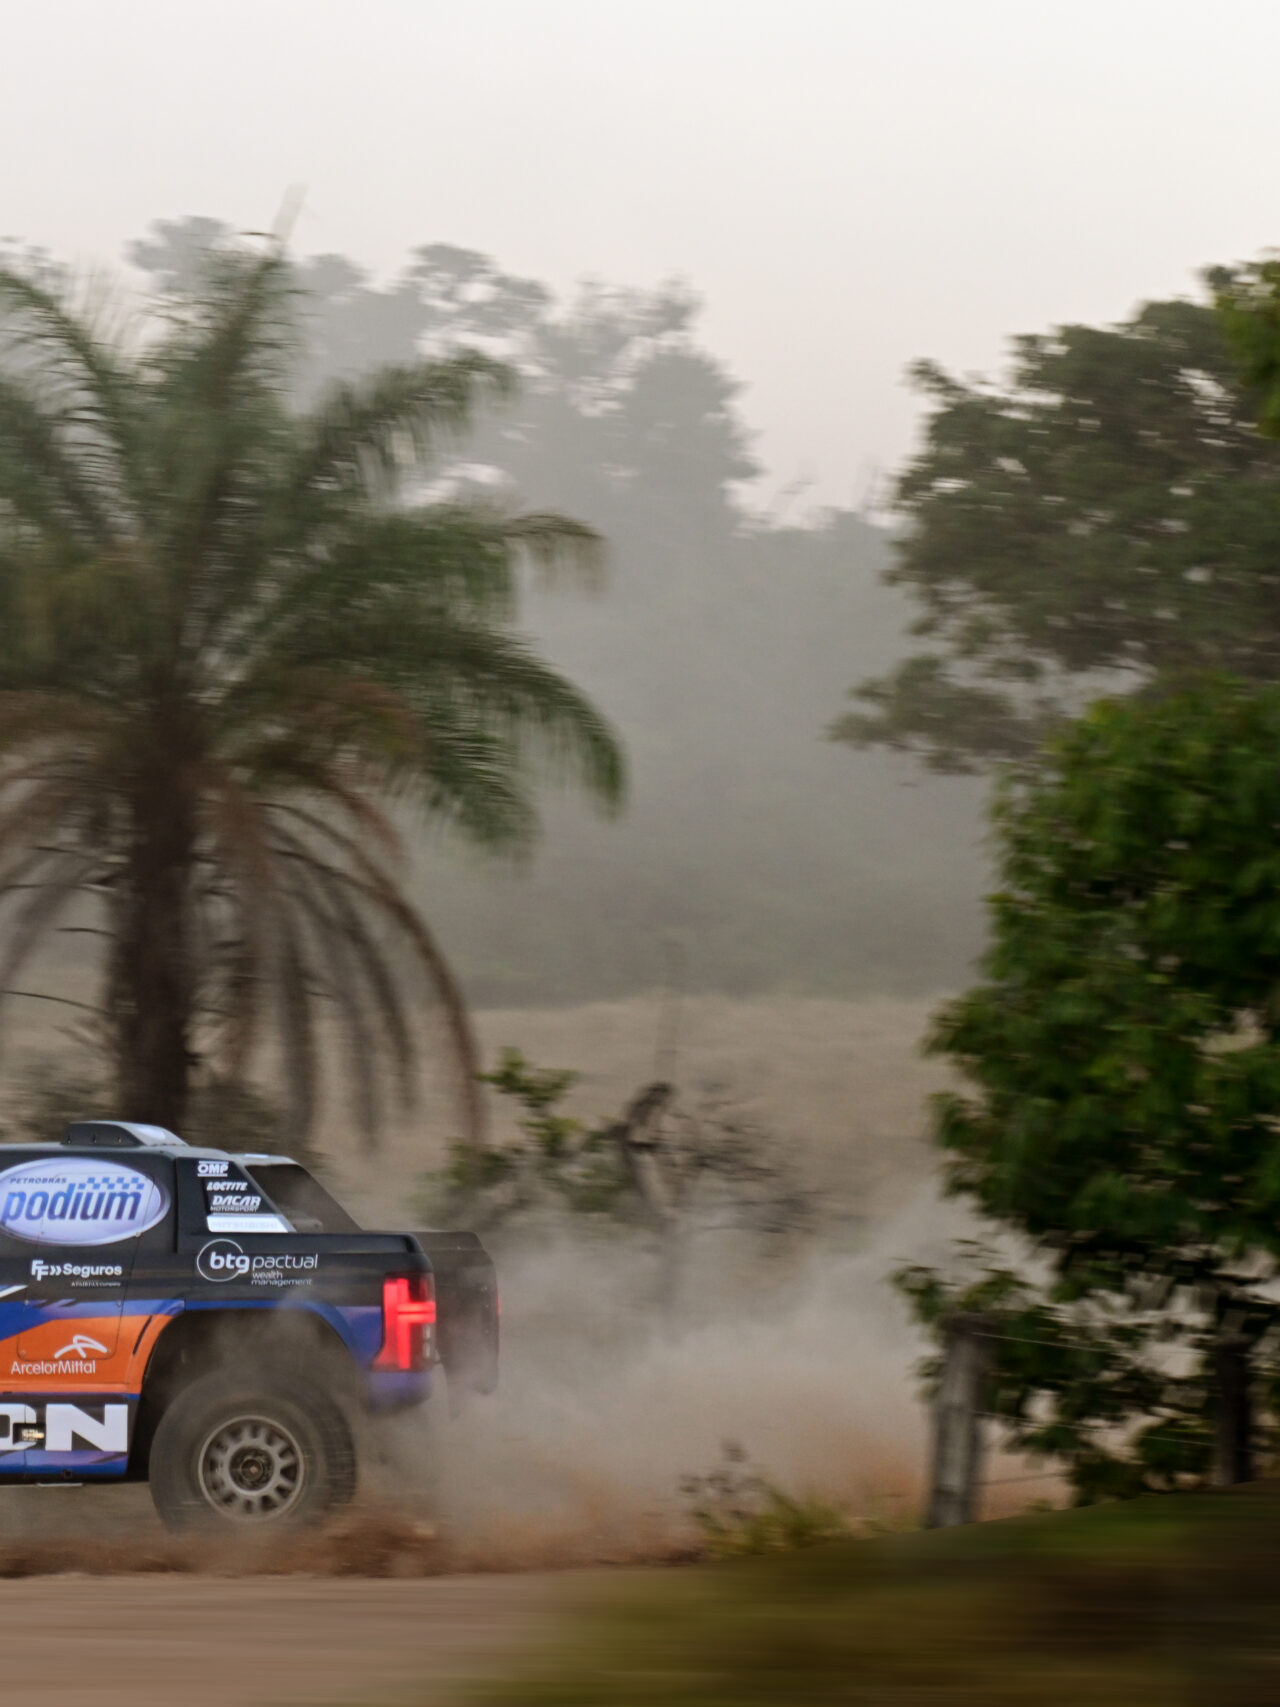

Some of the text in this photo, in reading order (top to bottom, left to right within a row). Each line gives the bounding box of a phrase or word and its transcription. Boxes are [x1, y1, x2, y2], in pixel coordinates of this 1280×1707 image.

[197, 1163, 229, 1175] OMP
[9, 1177, 68, 1185] PETROBRAS
[206, 1181, 248, 1191] LOCTITE
[0, 1183, 142, 1226] podium
[210, 1251, 319, 1274] btg pactual
[63, 1263, 122, 1278] Seguros
[252, 1270, 283, 1280] wealth
[251, 1279, 313, 1287] management
[10, 1360, 96, 1375] ArcelorMittal
